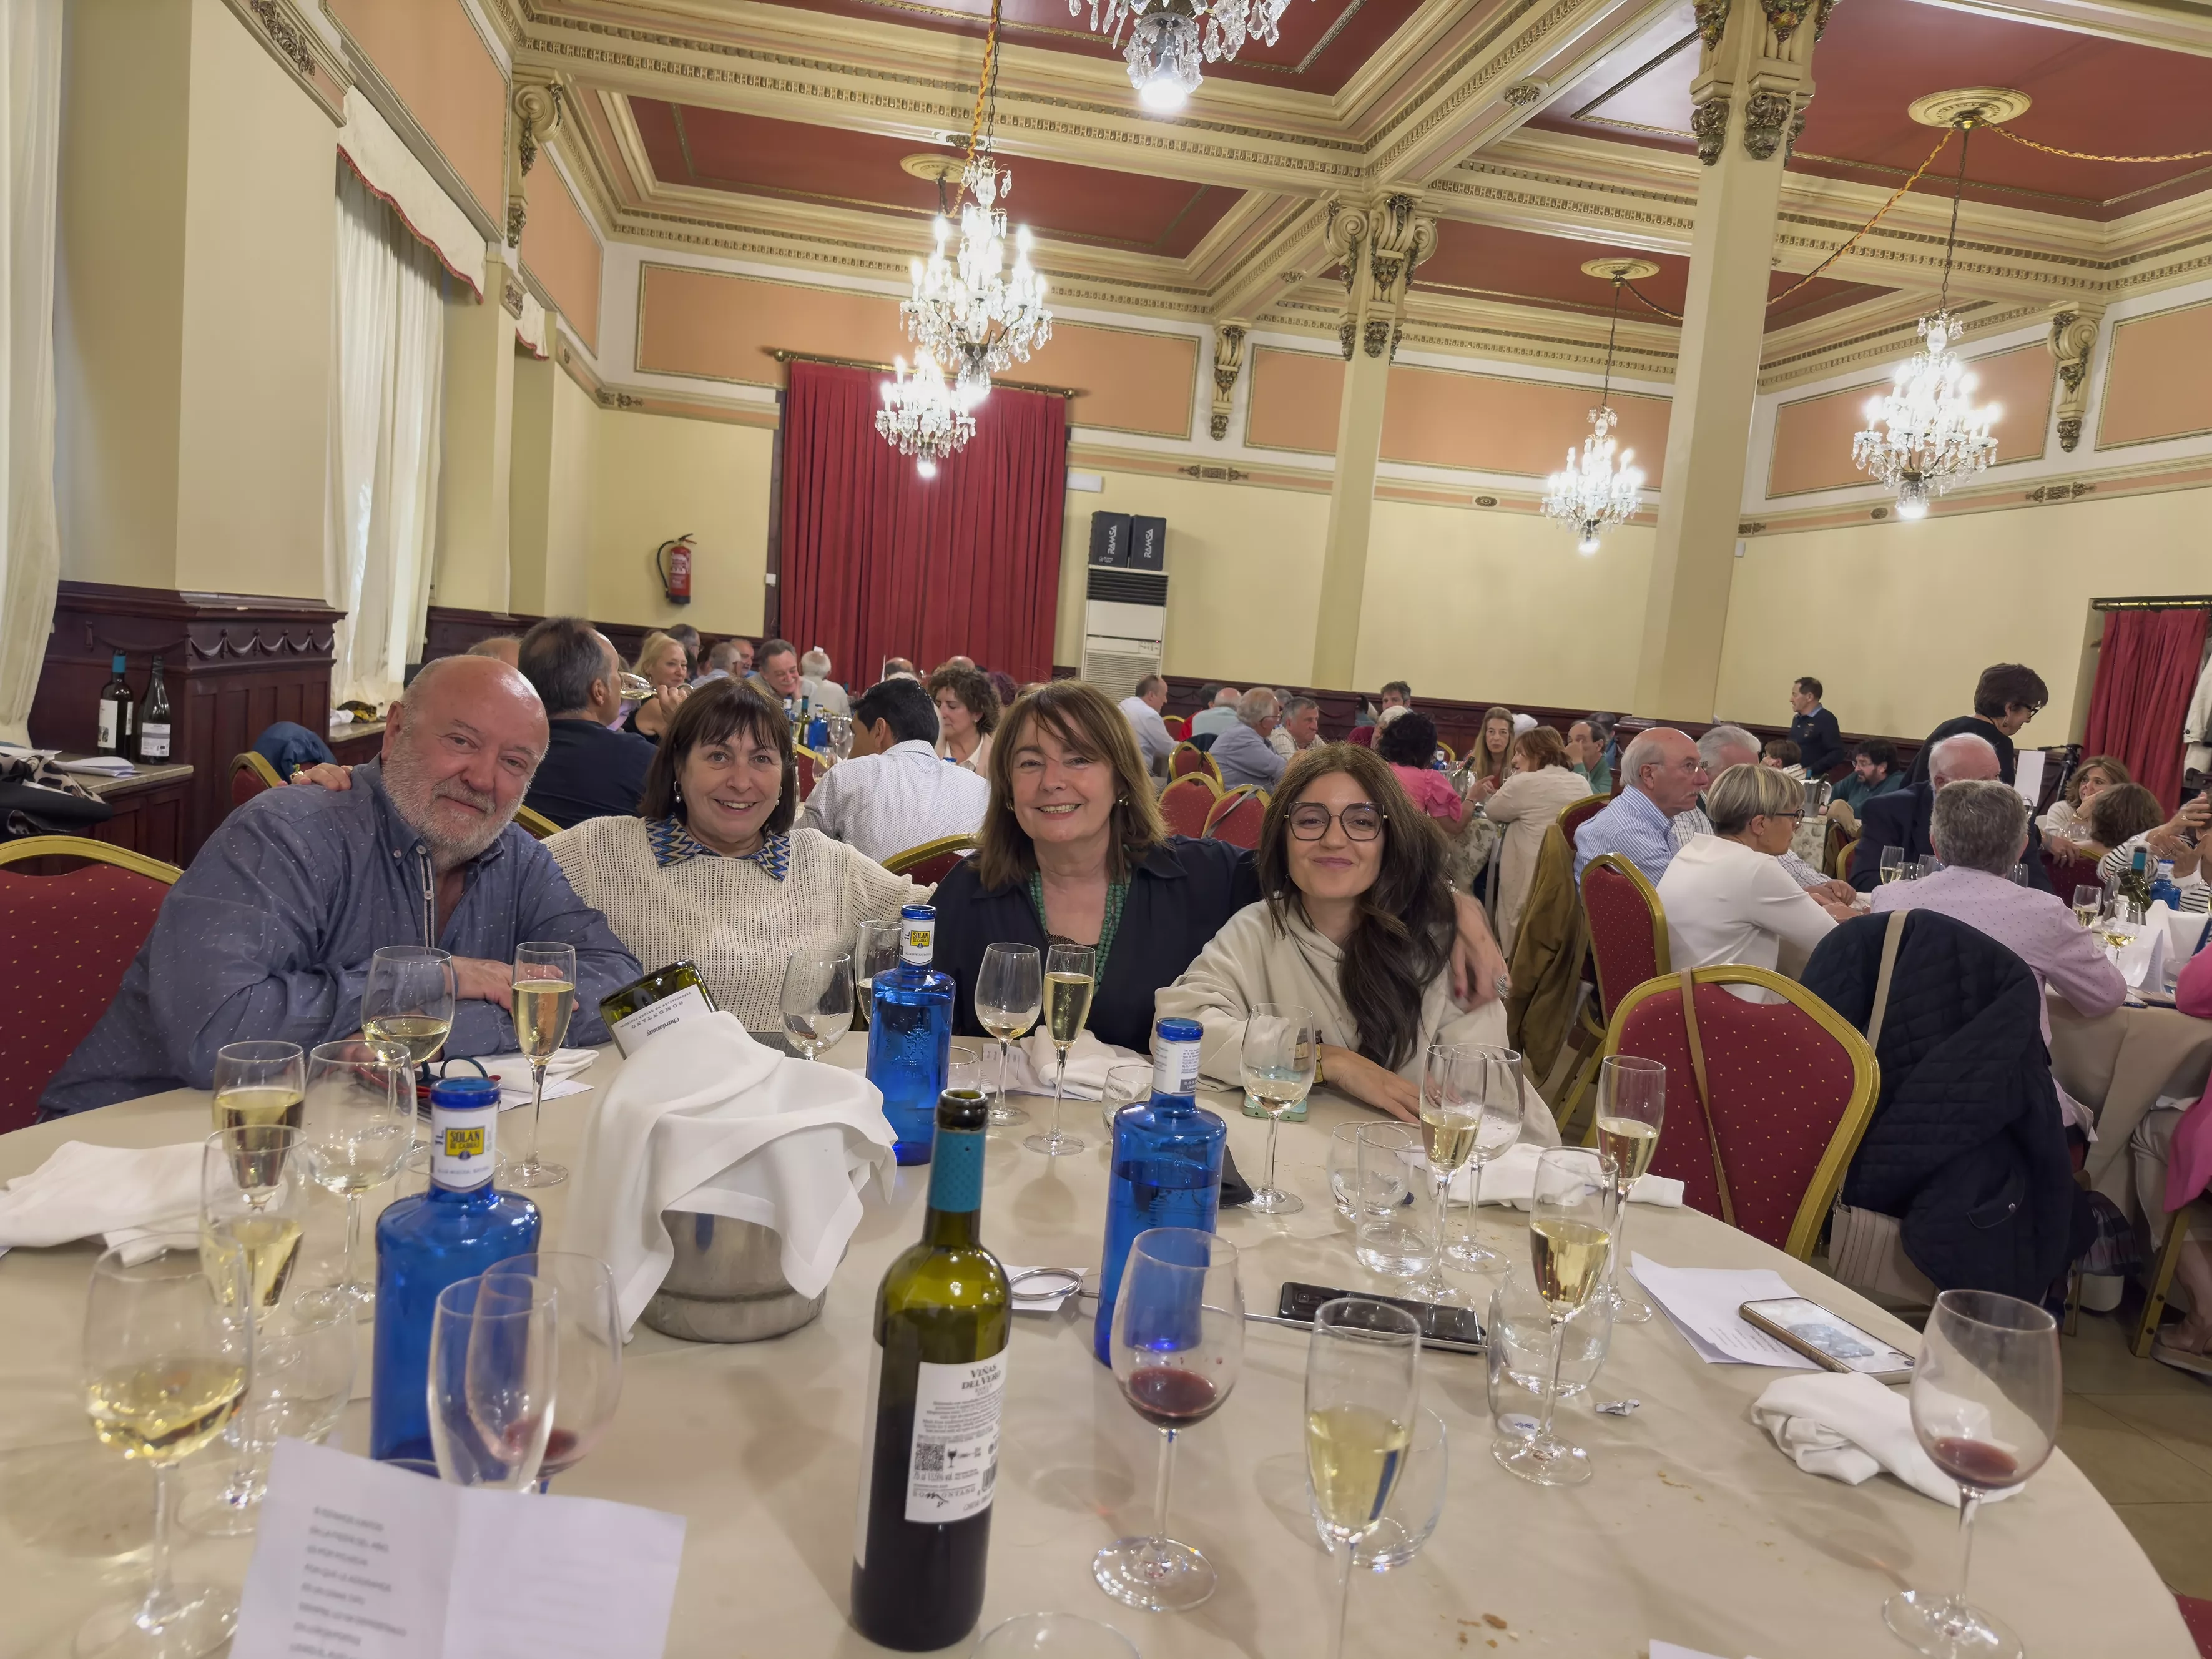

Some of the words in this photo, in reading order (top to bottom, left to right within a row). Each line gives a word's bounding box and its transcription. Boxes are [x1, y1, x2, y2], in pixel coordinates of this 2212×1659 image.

[1108, 525, 1117, 554] RAMSA
[1144, 529, 1153, 558] RAMSA
[631, 1000, 684, 1029] SOMONTANO
[647, 1017, 679, 1036] Chardonnay
[961, 1379, 981, 1389] DEL
[981, 1370, 1001, 1384] VERO
[971, 1363, 997, 1378] VIÑAS
